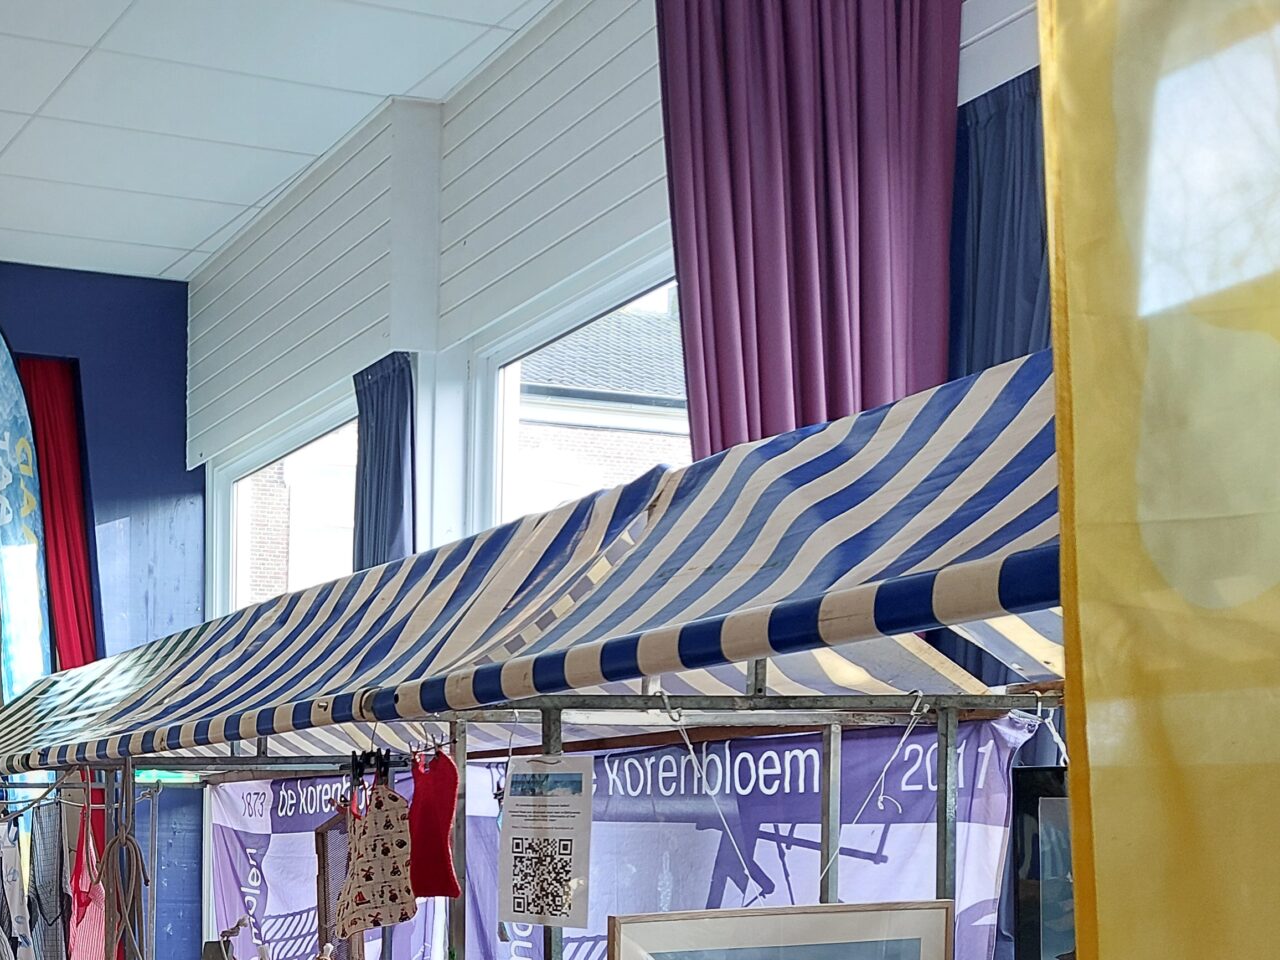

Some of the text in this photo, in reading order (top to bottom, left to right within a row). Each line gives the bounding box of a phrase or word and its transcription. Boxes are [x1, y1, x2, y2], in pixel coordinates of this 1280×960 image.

[606, 740, 820, 797] korenbloem
[241, 791, 266, 818] 1873
[278, 781, 297, 817] de
